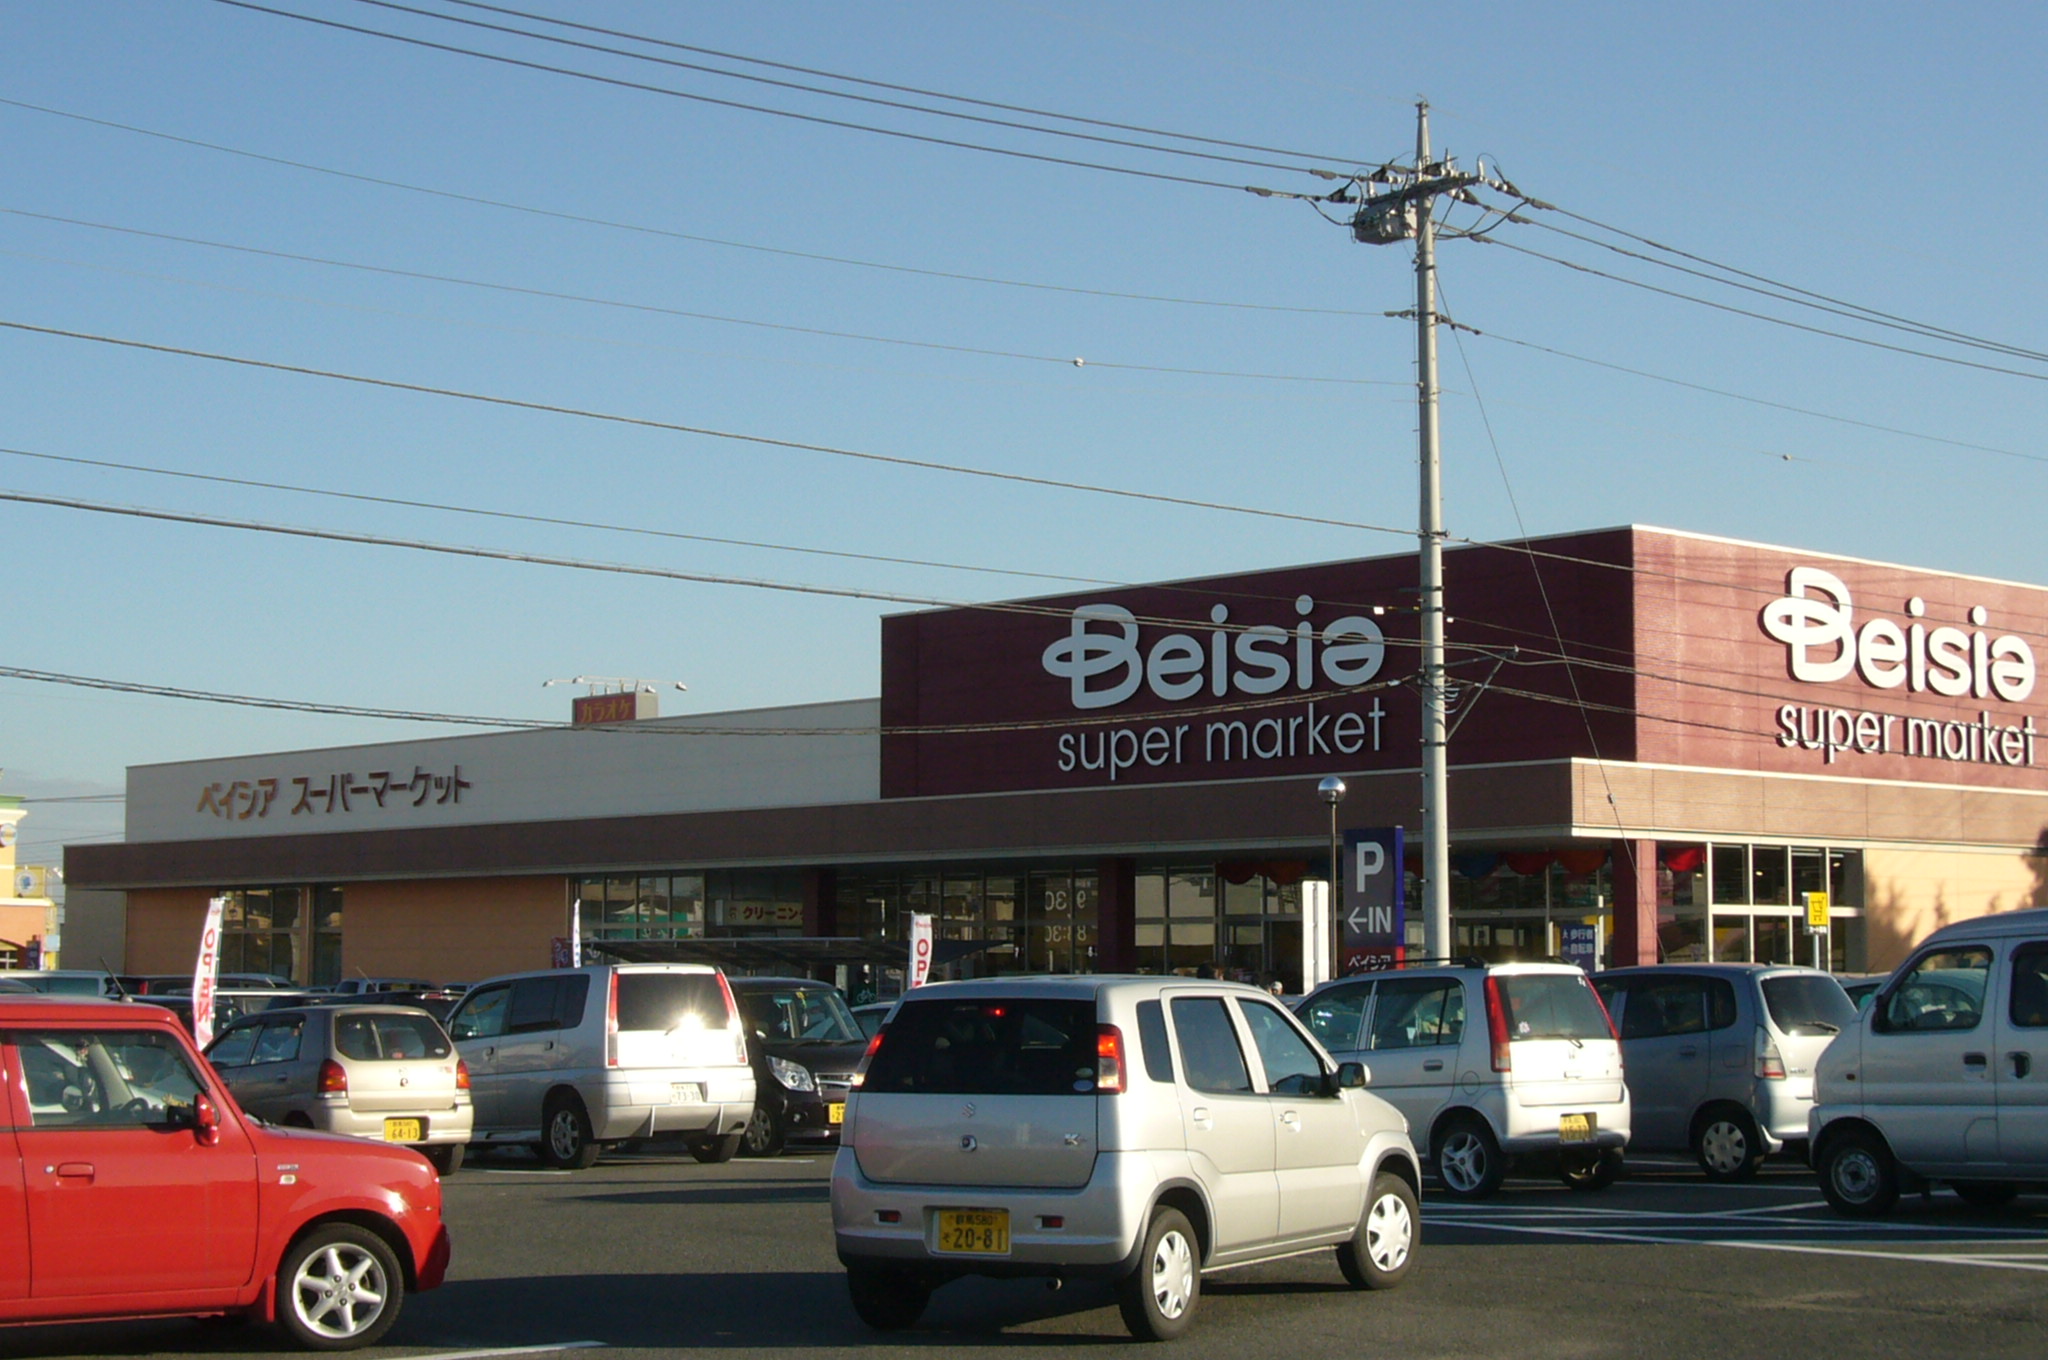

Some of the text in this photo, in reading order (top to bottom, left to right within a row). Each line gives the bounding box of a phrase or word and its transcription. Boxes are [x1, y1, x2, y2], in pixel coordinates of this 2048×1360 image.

[1042, 594, 1385, 709] Beisia
[1762, 567, 2036, 702] Beisia
[1058, 697, 1386, 780] super market
[1779, 704, 2037, 766] super market
[197, 765, 471, 820] ベイシア スーパーマーケット
[1356, 841, 1385, 893] P
[1368, 906, 1392, 933] IN
[912, 938, 930, 988] OP
[953, 1227, 1004, 1250] 20-81
